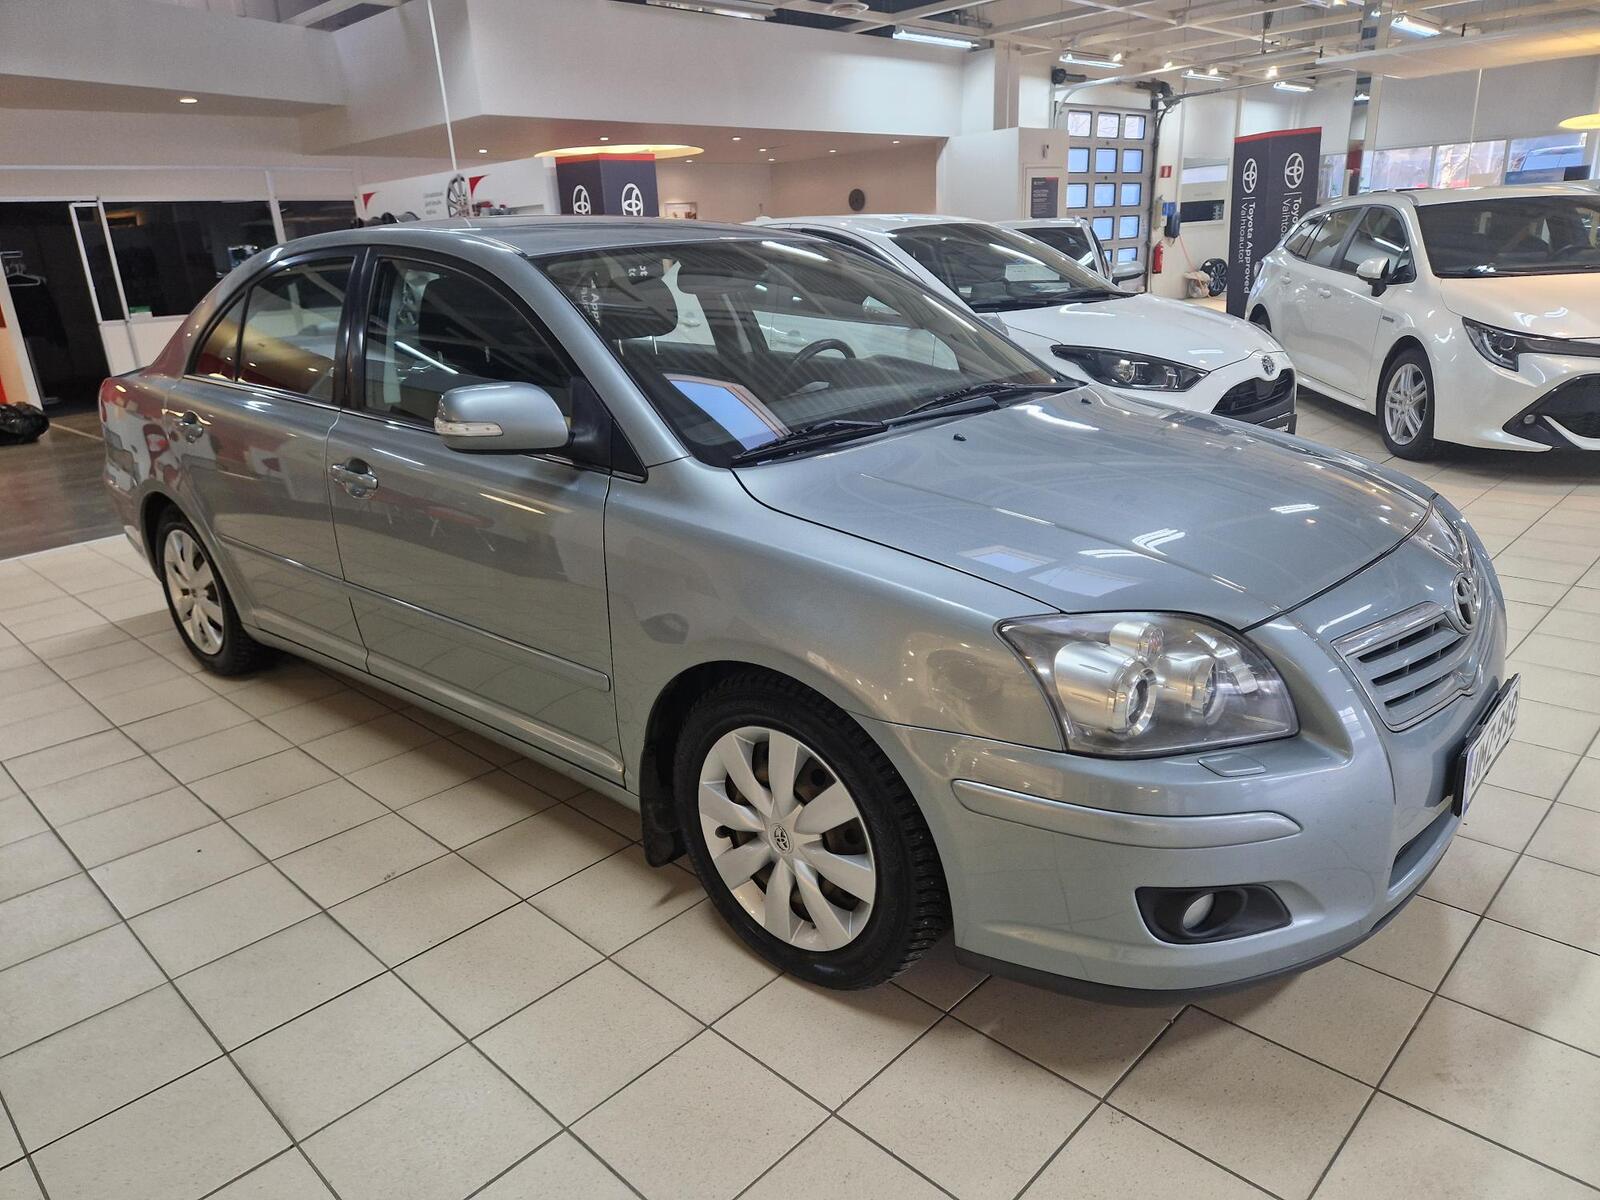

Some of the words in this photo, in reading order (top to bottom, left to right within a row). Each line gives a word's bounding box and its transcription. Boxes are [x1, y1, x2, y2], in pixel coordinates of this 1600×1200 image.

[1239, 203, 1247, 263] Vaihtoautot
[1247, 202, 1256, 239] Toyota
[1244, 241, 1254, 294] Approved
